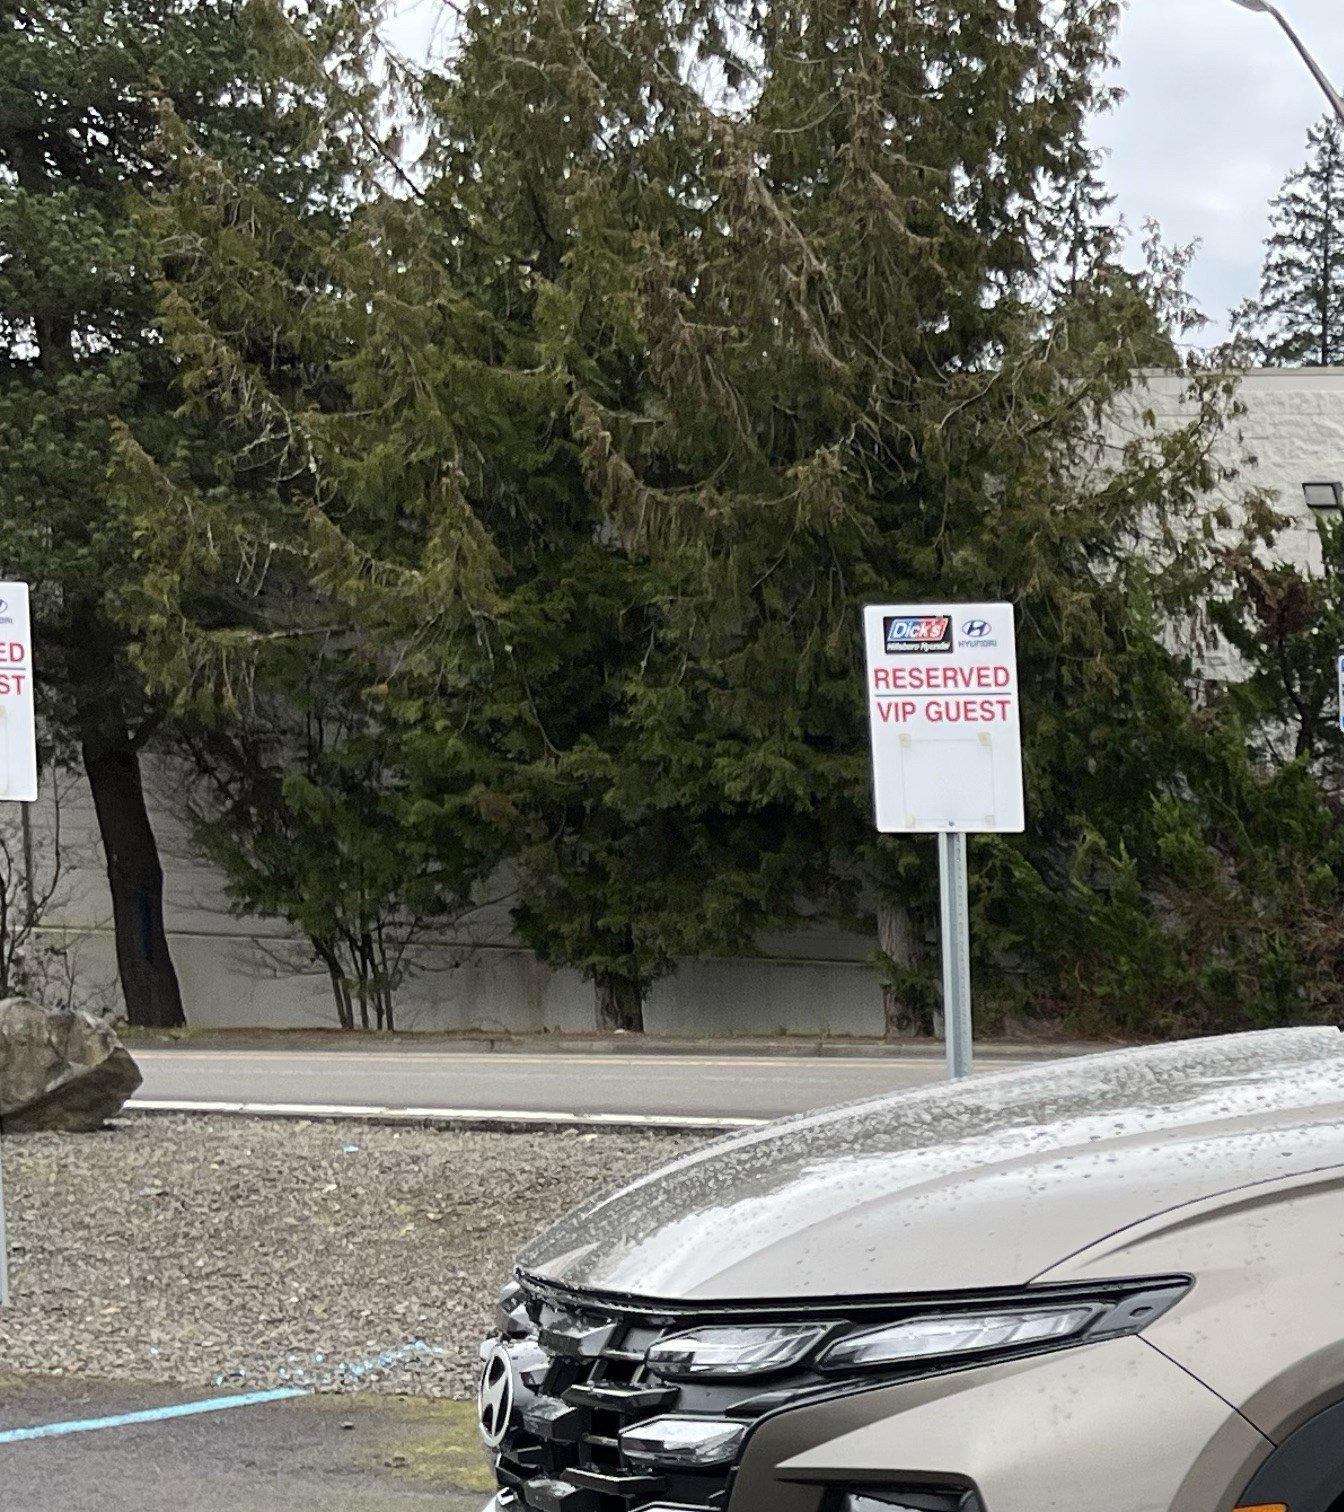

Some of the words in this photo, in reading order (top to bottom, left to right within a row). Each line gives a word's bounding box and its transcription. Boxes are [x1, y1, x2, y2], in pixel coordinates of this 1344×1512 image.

[873, 666, 1011, 690] RESERVED
[877, 702, 916, 723] VIP
[925, 700, 1011, 722] GUEST
